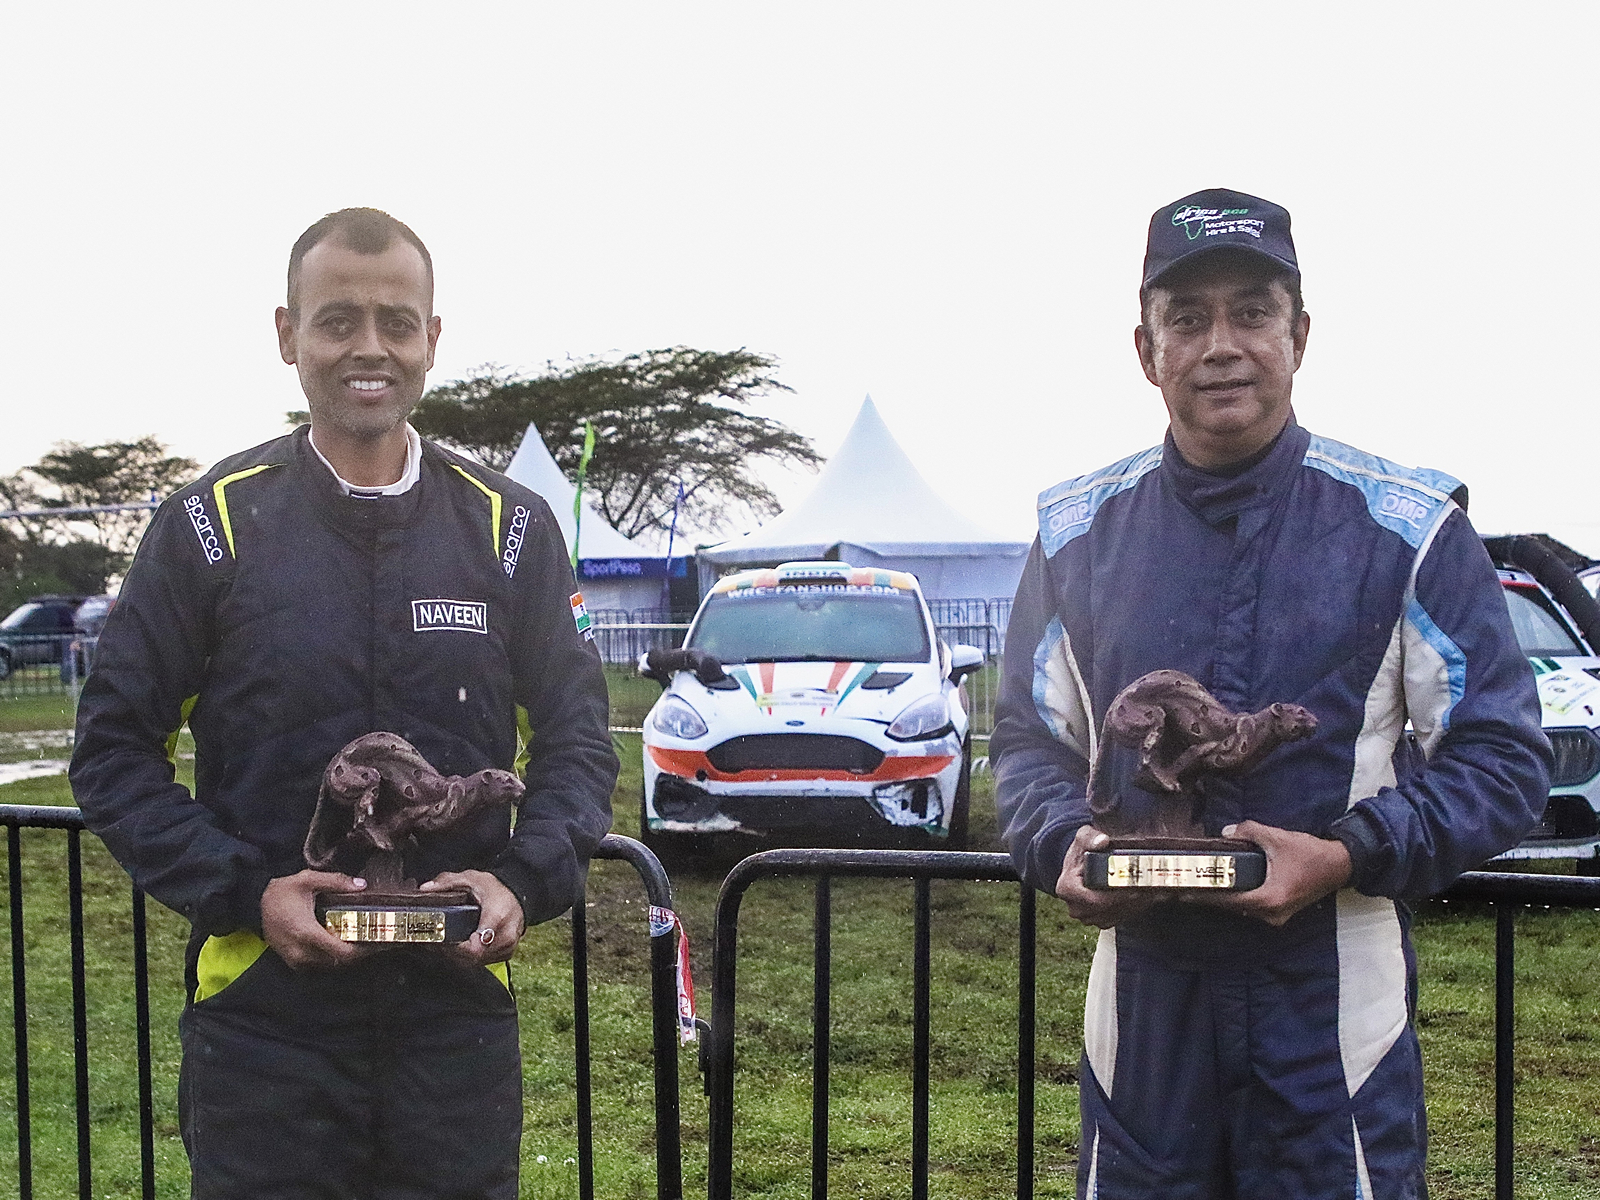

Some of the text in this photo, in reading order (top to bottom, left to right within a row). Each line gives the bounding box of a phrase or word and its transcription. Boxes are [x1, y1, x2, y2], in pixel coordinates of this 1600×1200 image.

[1205, 219, 1265, 230] Motorsport
[1205, 228, 1228, 237] Hire
[1050, 502, 1089, 531] OMP
[1382, 494, 1428, 520] OMP
[184, 495, 223, 564] sparco
[420, 604, 482, 627] NAVEEN
